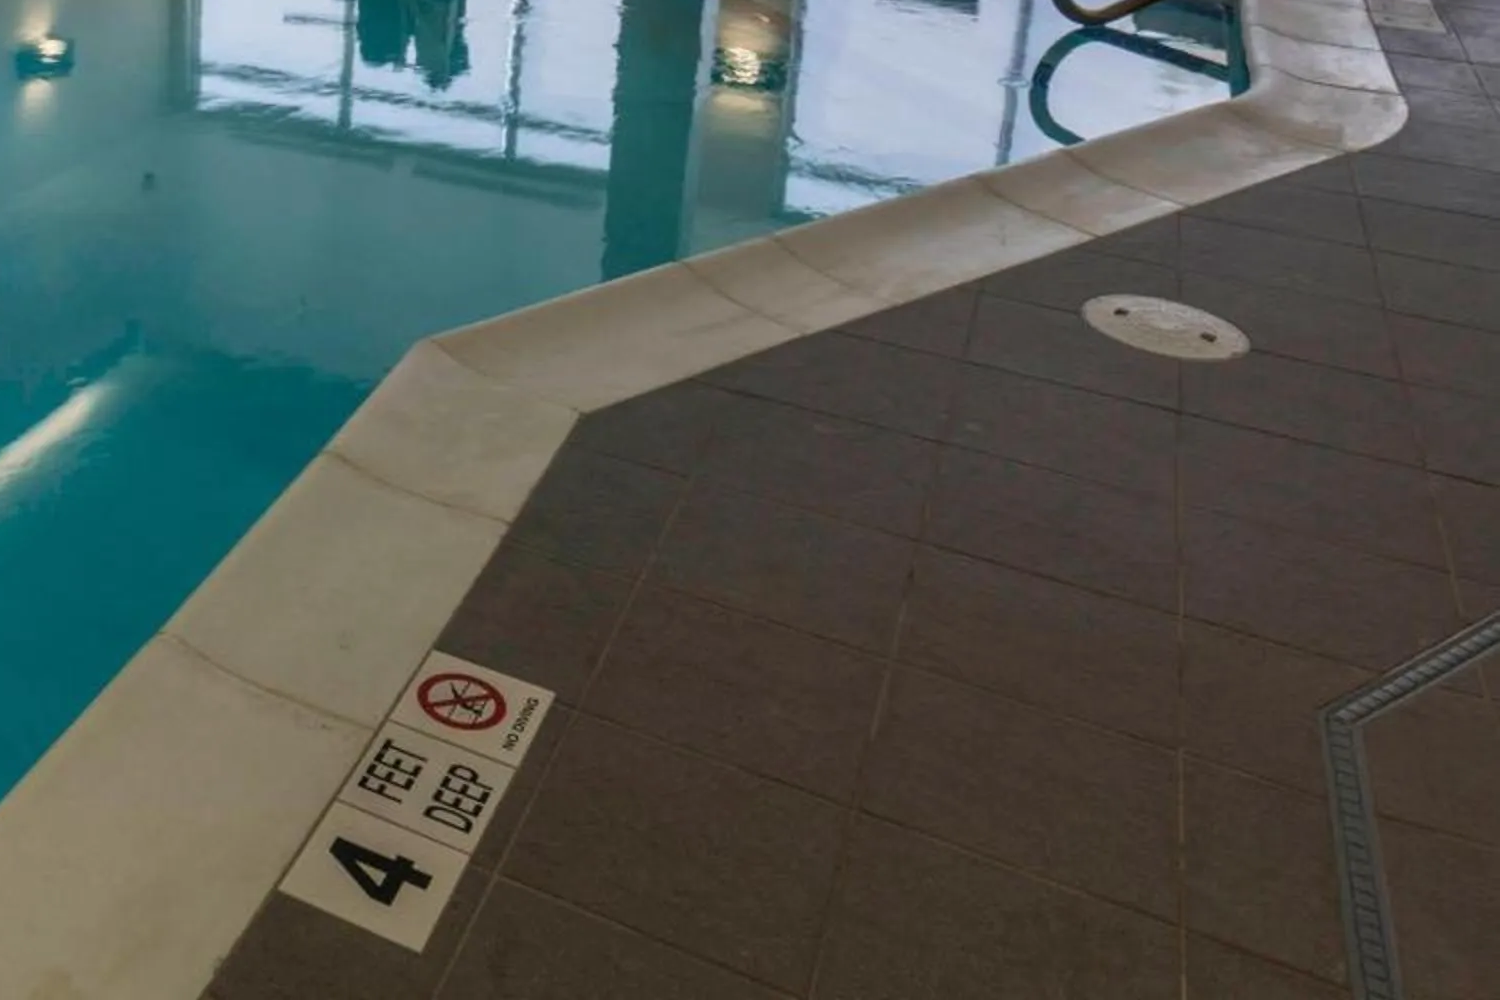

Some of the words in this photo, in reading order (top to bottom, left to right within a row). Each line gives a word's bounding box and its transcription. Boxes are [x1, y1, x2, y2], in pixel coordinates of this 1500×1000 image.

[501, 732, 520, 752] NO
[511, 697, 540, 734] DIVING
[357, 739, 429, 803] FEET
[423, 763, 495, 835] DEEP
[328, 836, 433, 907] 4
